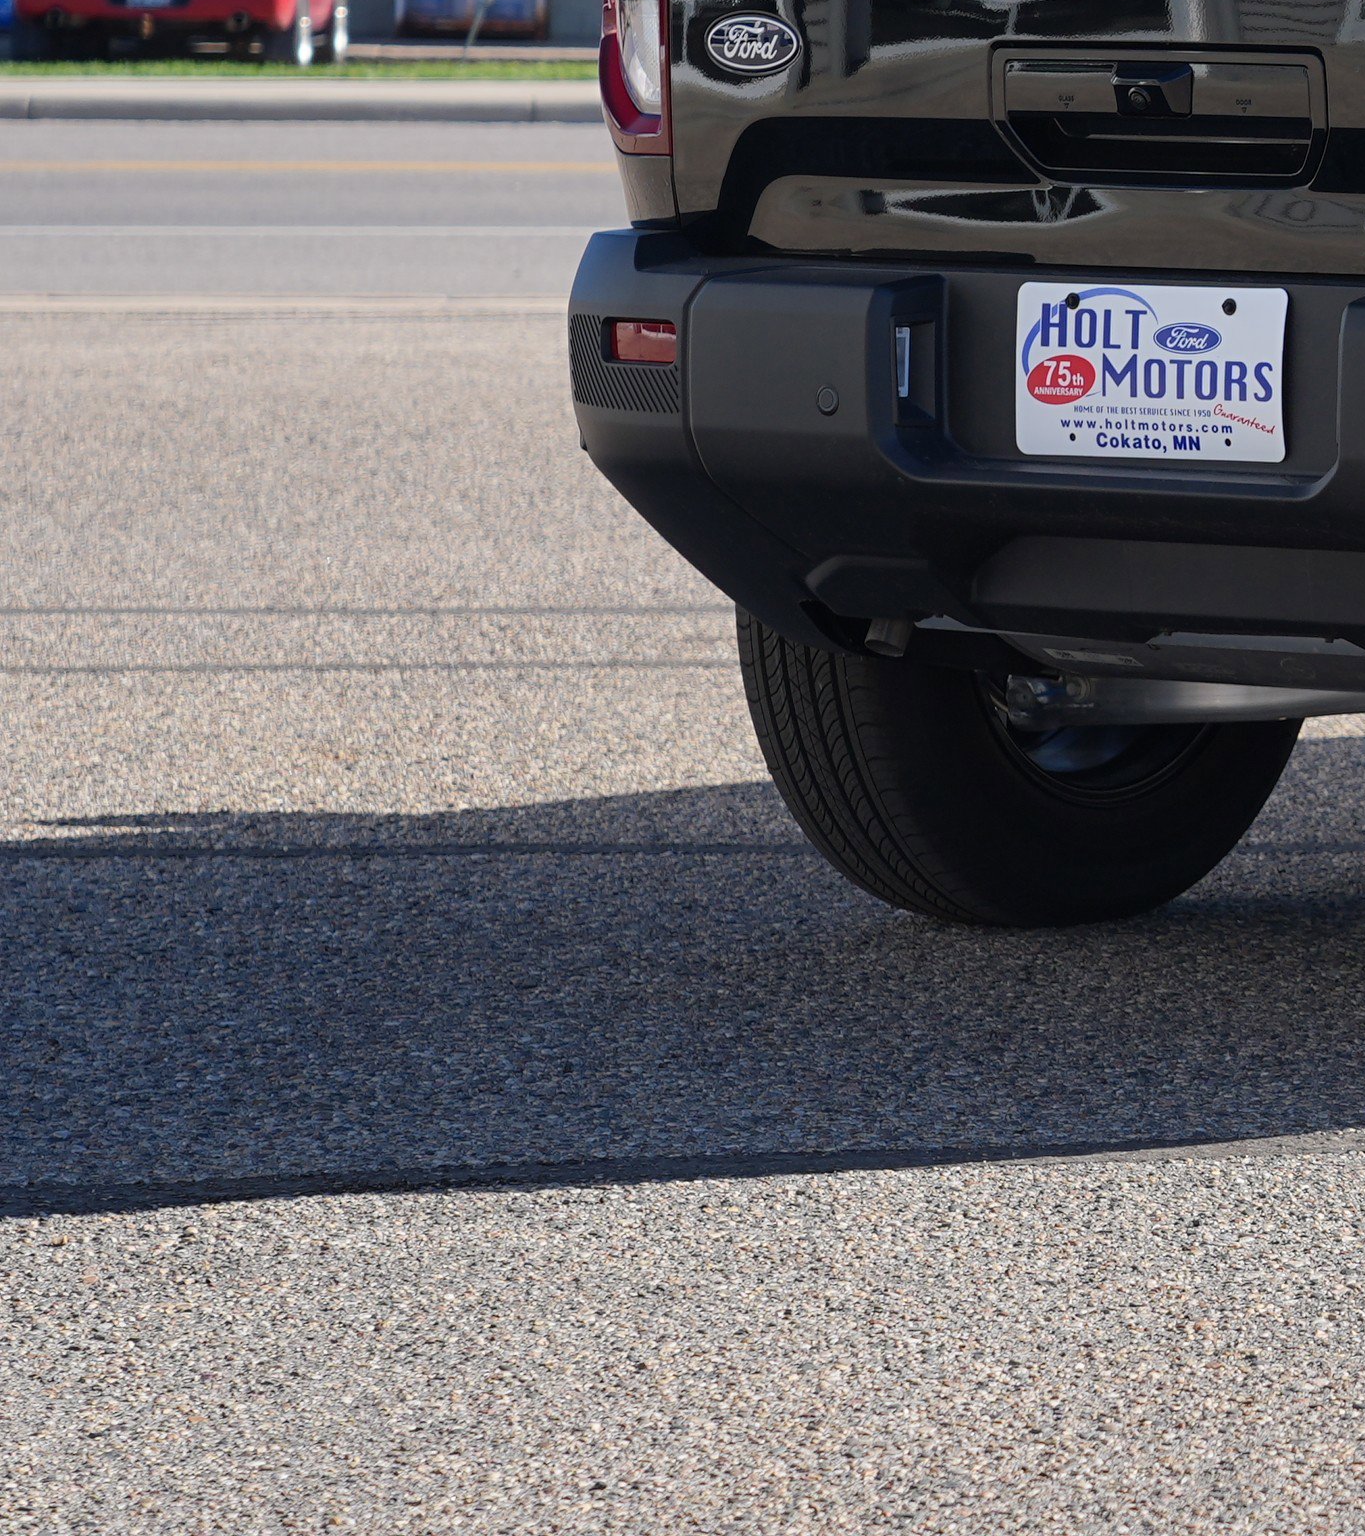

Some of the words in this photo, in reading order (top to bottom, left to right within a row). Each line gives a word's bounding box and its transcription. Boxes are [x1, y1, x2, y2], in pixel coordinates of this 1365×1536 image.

[723, 24, 779, 60] Ford
[1040, 302, 1148, 350] HOLT
[1166, 327, 1208, 350] Ford
[1043, 360, 1084, 386] 75th
[1102, 353, 1274, 402] MOTORS
[1034, 386, 1084, 396] ANNIVERSARY
[1074, 405, 1094, 414] HOME
[1096, 406, 1104, 414] OF
[1106, 406, 1119, 415] THE
[1121, 406, 1137, 415] BEST
[1139, 407, 1167, 416] SERVICE
[1170, 408, 1191, 417] SINCE
[1193, 409, 1211, 418] 1950
[1213, 403, 1276, 436] Guaranteed
[1060, 418, 1234, 434] www.holtmotors.com
[1096, 432, 1167, 453] Cokato,
[1173, 435, 1201, 451] MN
